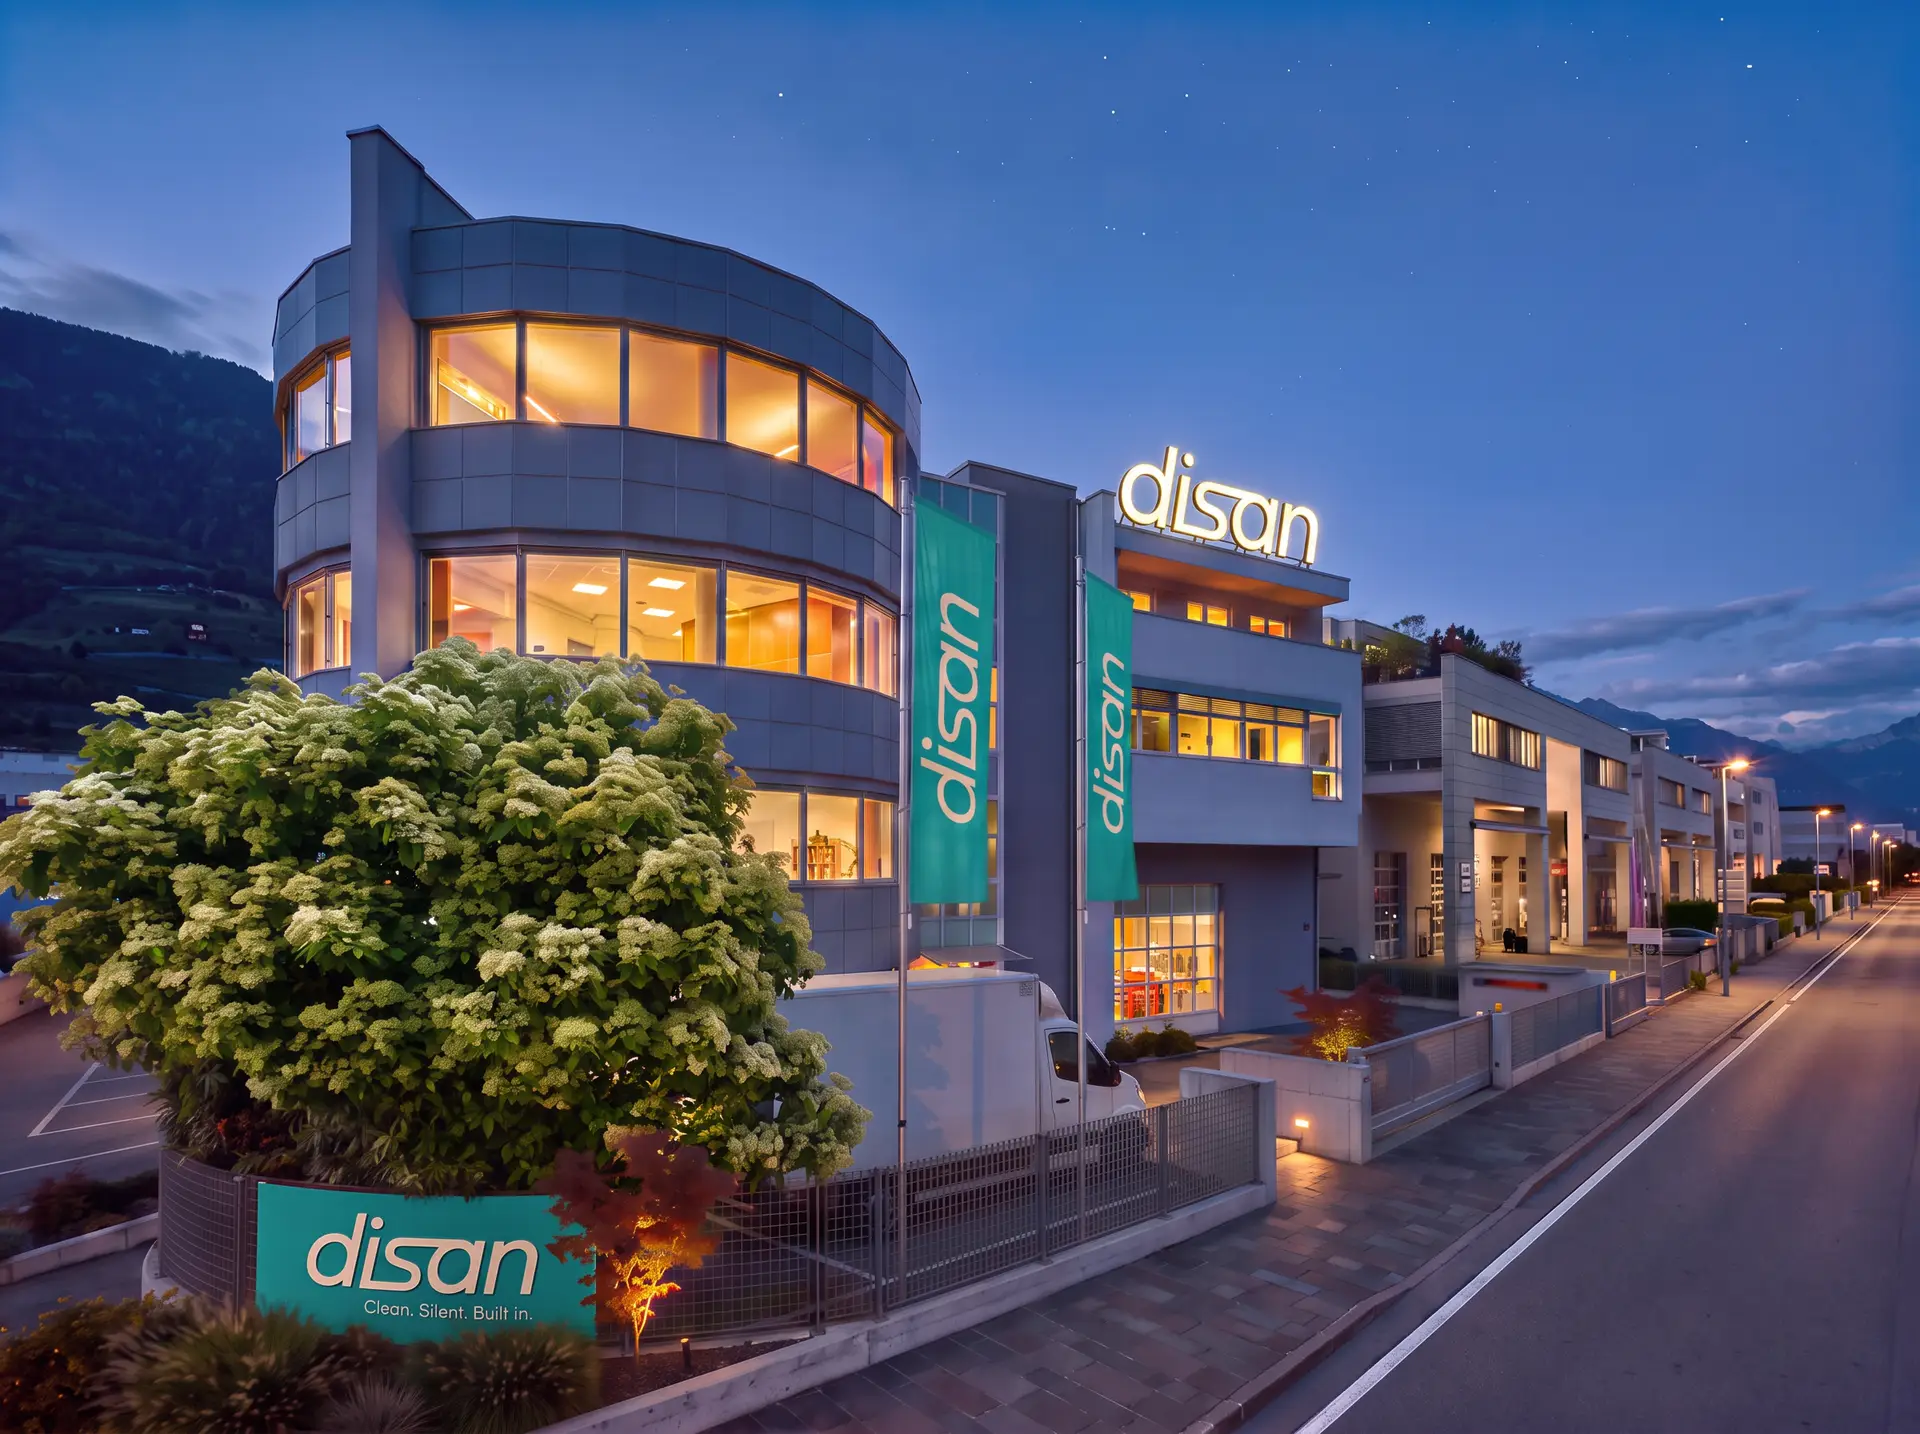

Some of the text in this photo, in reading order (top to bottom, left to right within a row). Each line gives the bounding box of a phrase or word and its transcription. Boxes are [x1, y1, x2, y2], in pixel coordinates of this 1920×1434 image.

[1118, 446, 1319, 565] disan
[920, 592, 980, 824] disan
[1093, 652, 1125, 834] disan
[306, 1212, 539, 1295] disan
[364, 1300, 533, 1321] Clean. Silent. Built in.
